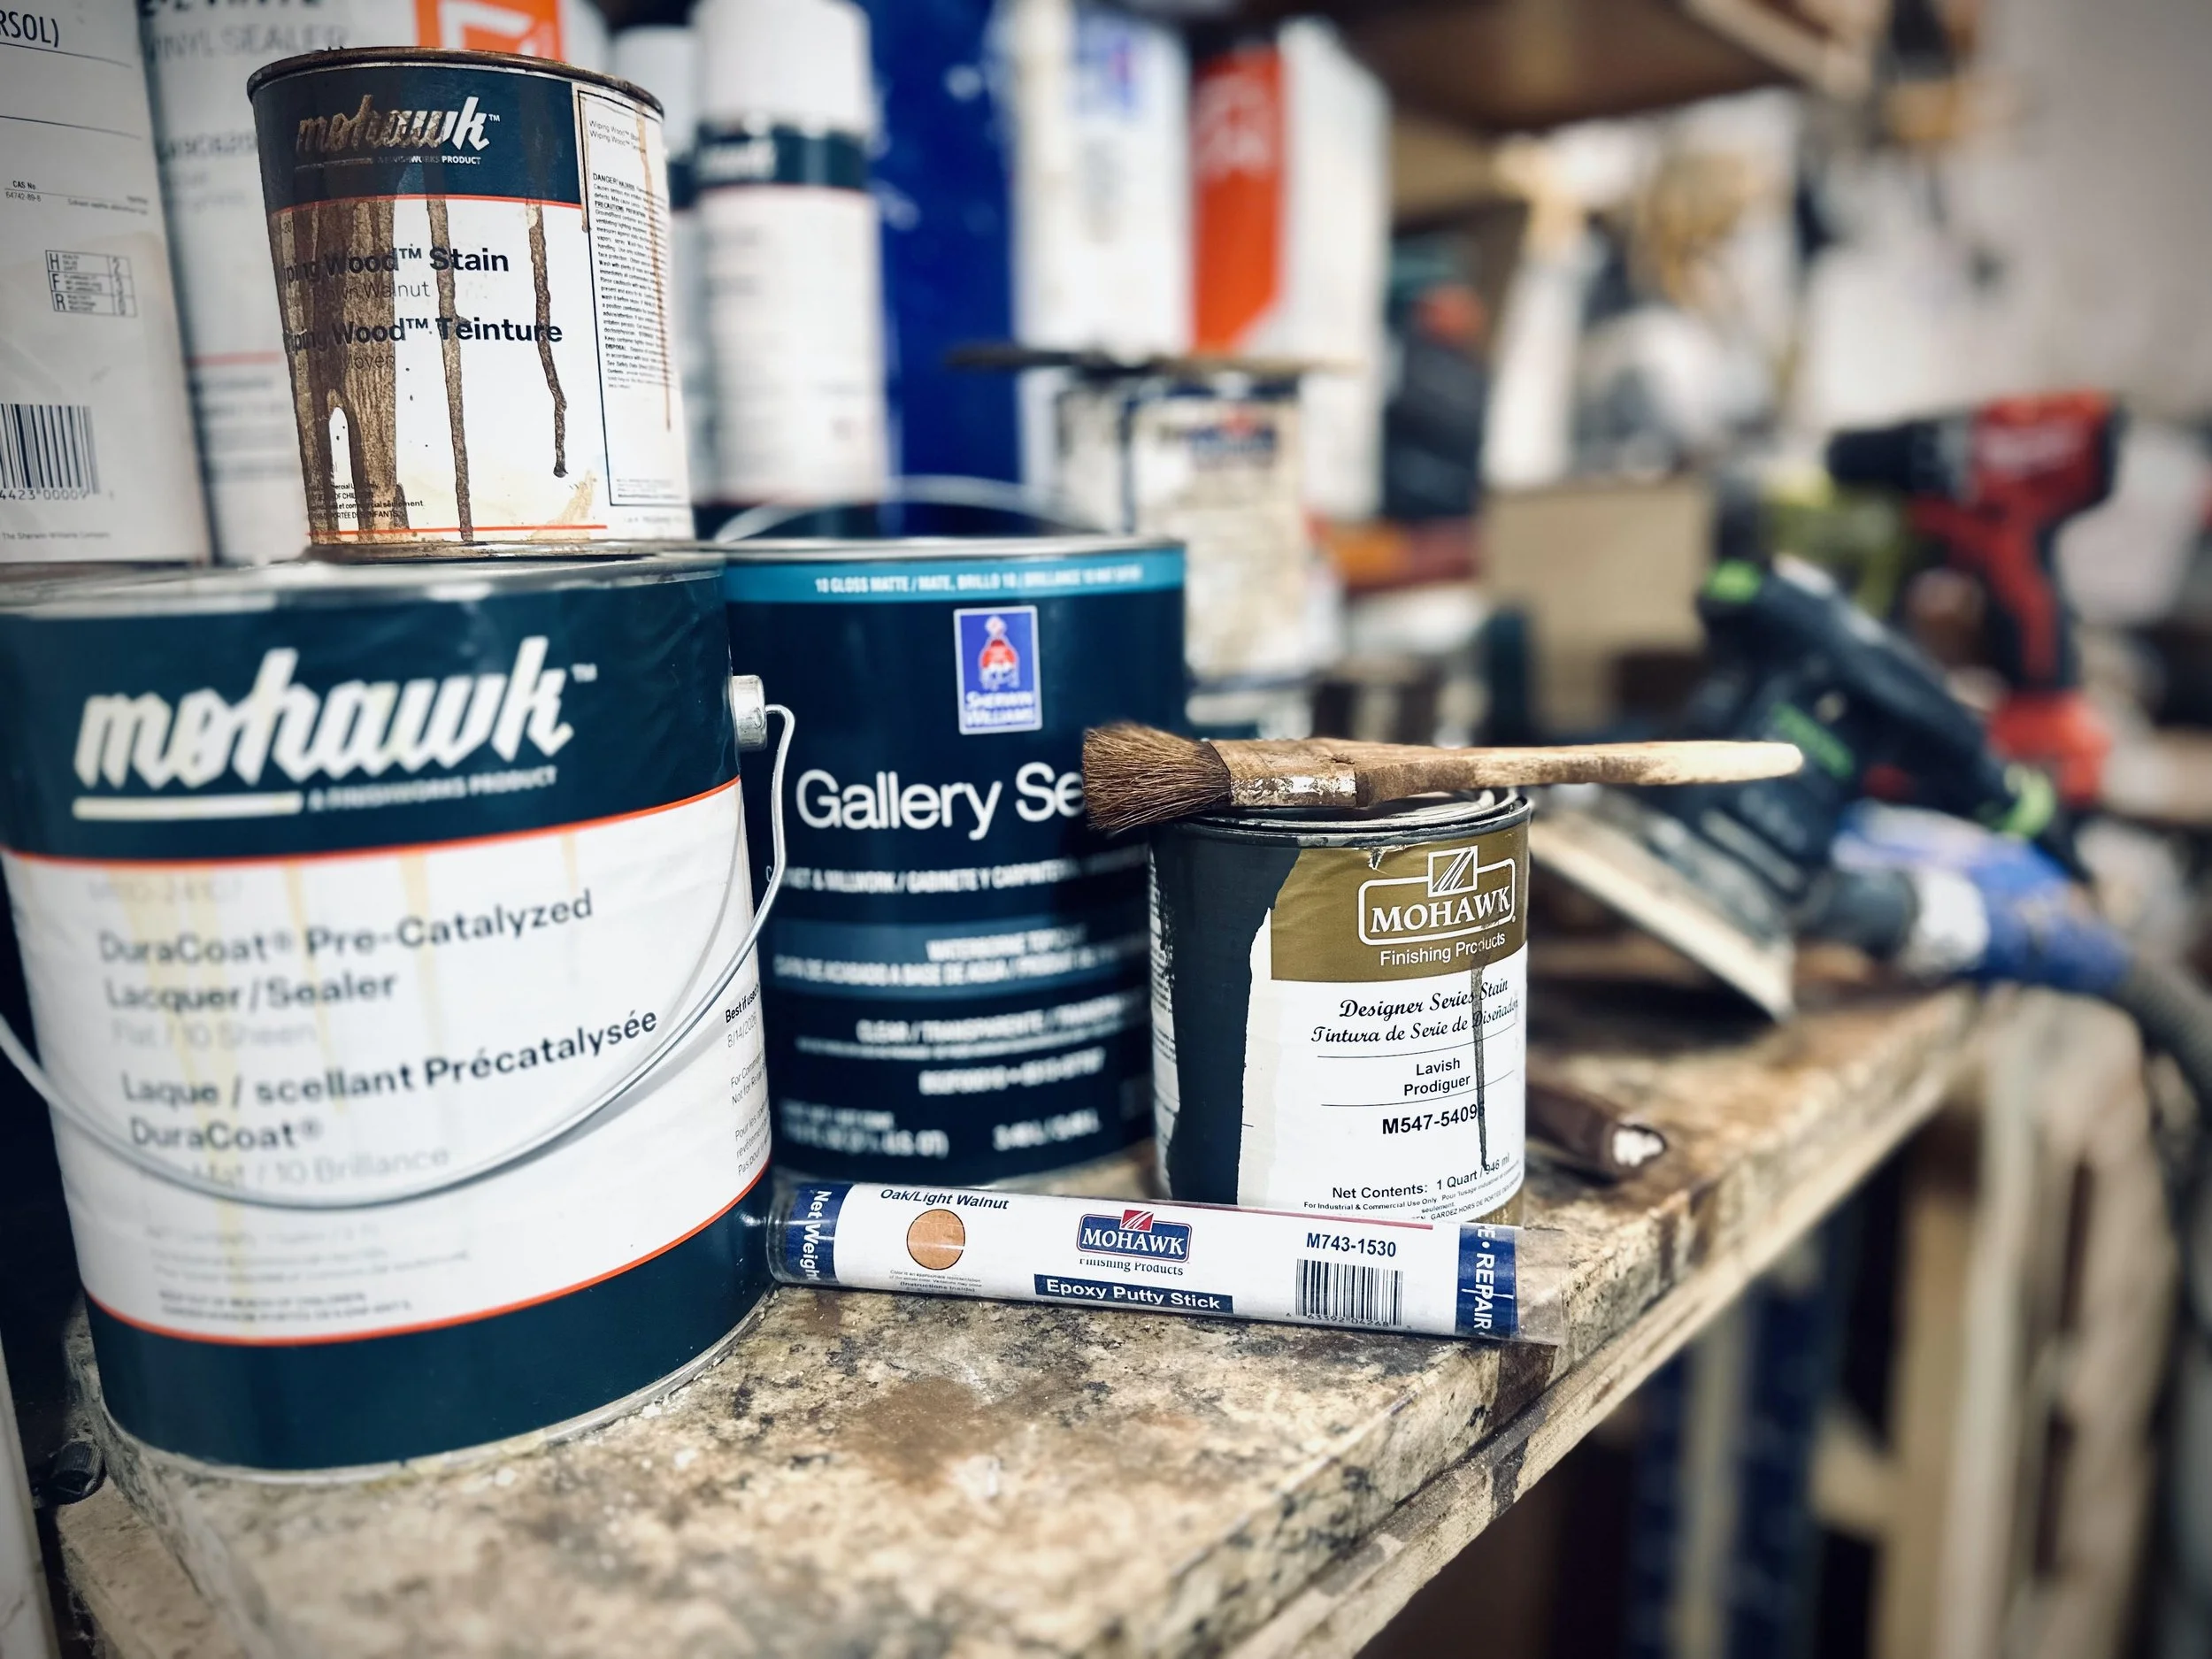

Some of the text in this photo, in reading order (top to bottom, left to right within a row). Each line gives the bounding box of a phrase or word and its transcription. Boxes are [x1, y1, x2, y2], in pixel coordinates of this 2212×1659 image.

[442, 156, 481, 165] PRODUCT
[12, 180, 26, 189] CAS
[49, 253, 60, 271] H
[429, 247, 510, 272] Stain
[51, 273, 61, 290] F
[363, 280, 432, 298] Walnut
[55, 294, 65, 311] R
[435, 317, 563, 342] Teinture
[468, 765, 558, 797] PRODUCT
[795, 762, 1002, 840] Gallery
[304, 888, 595, 957] Pre-Catalyzed
[1379, 932, 1506, 966] Finishing Products
[104, 976, 241, 1017] Lacquer
[265, 971, 397, 1009] Sealer
[1339, 978, 1509, 1022] Designer Series Stain
[725, 1001, 742, 1024] Best
[1310, 1025, 1381, 1043] Tintura
[1385, 1025, 1405, 1041] de
[1410, 1022, 1448, 1040] Serie
[1451, 1016, 1469, 1033] de
[121, 1070, 219, 1108] Laque
[255, 1065, 416, 1106] scellant
[425, 1007, 659, 1088] Précatalysée
[1416, 1057, 1461, 1076] Lavish
[730, 1073, 741, 1088] For
[1404, 1074, 1471, 1096] Prodiguer
[314, 1148, 451, 1185] Brillance
[1332, 1187, 1356, 1199] Net
[1361, 1184, 1428, 1198] Contents:
[1436, 1179, 1442, 1190] 1
[1447, 1171, 1478, 1188] Quart
[879, 1188, 1010, 1210] Oak/Light Walnut
[1363, 1202, 1405, 1210] Commercial
[1422, 1197, 1437, 1206] Only
[1430, 1208, 1458, 1221] GARDEZ
[1458, 1203, 1476, 1213] HORS
[1476, 1199, 1484, 1208] DE
[799, 1189, 833, 1282] Net Weigh
[1081, 1226, 1185, 1256] MOHAWK
[1306, 1232, 1397, 1258] M743-1530
[1134, 1262, 1184, 1276] Products
[1046, 1279, 1221, 1310] Epoxy Putty Stick
[1473, 1252, 1495, 1329] REPAIR
